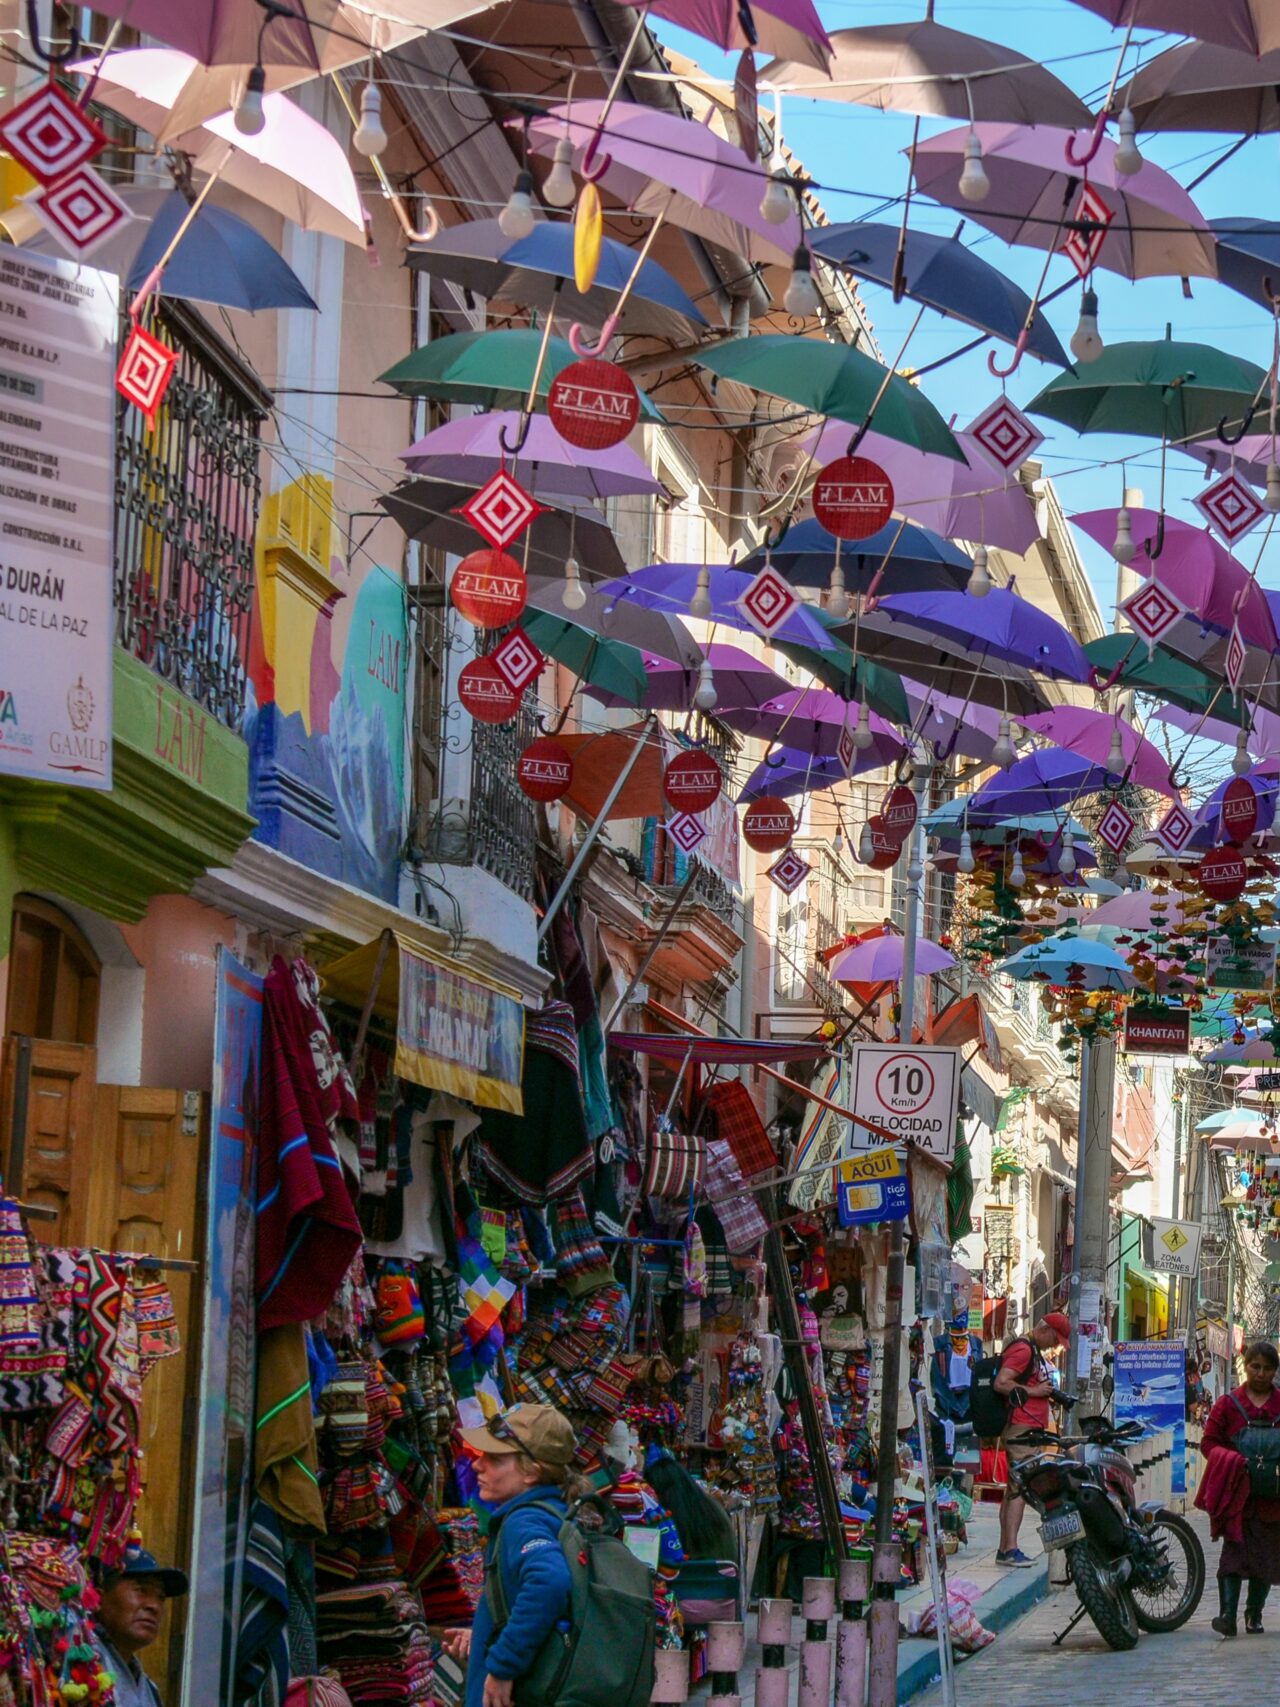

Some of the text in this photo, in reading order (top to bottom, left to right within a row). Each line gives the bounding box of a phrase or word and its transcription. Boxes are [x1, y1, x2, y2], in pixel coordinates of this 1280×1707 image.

[52, 497, 77, 514] OBRAS
[2, 522, 61, 547] CONSTRUCCIÓN
[7, 567, 65, 602] DURÁN
[19, 605, 37, 626] DE
[41, 611, 58, 631] LA
[62, 616, 89, 638] PAZ
[367, 619, 401, 694] LAM
[49, 731, 109, 762] GAMLP
[154, 683, 208, 785] LAM
[1128, 1026, 1185, 1040] KHANTATI
[887, 1067, 924, 1096] 10
[890, 1097, 917, 1108] Km/h
[851, 1156, 893, 1180] AQUÍ
[1154, 1260, 1190, 1272] EATONES
[1160, 1254, 1181, 1263] ZONA
